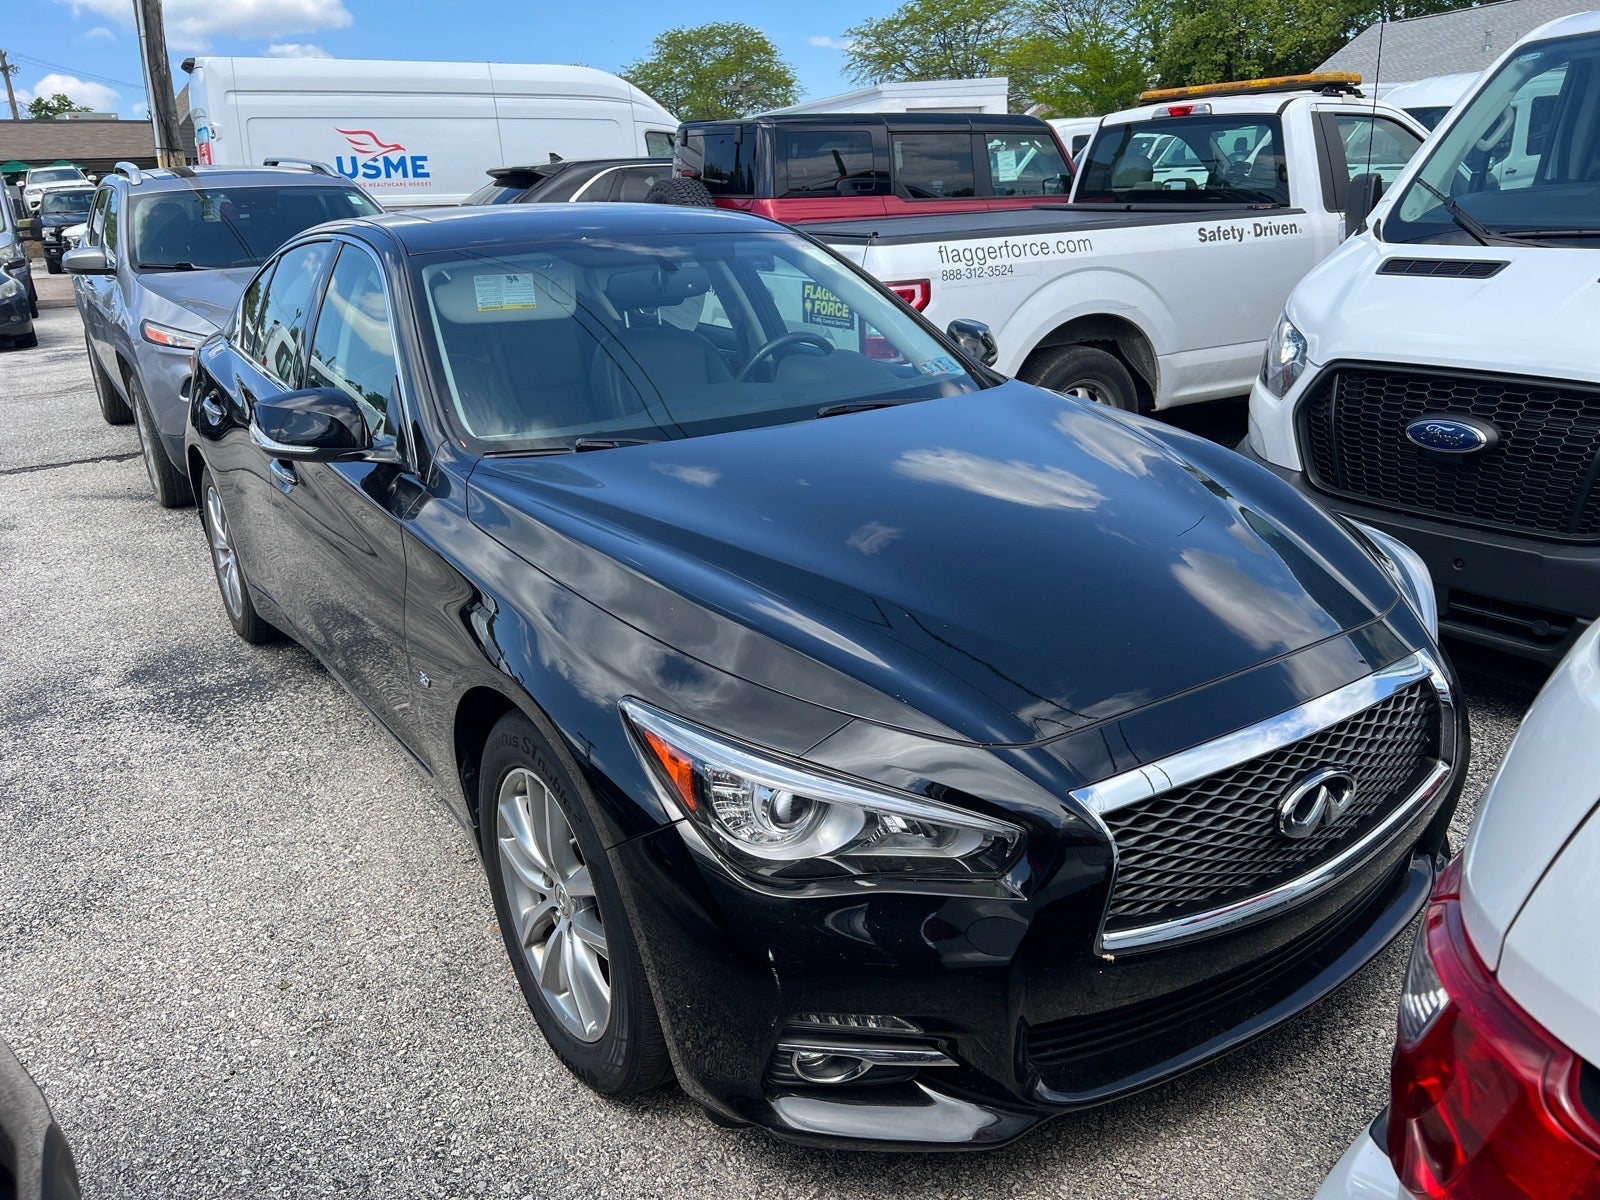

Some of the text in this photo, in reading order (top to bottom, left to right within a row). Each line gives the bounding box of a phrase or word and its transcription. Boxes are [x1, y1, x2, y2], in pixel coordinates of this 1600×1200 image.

[336, 156, 430, 179] USME
[1198, 226, 1244, 242] Safety
[938, 238, 1093, 267] flaggerforce.com
[941, 264, 1014, 281] 888-312-3524
[814, 300, 849, 317] FORCE
